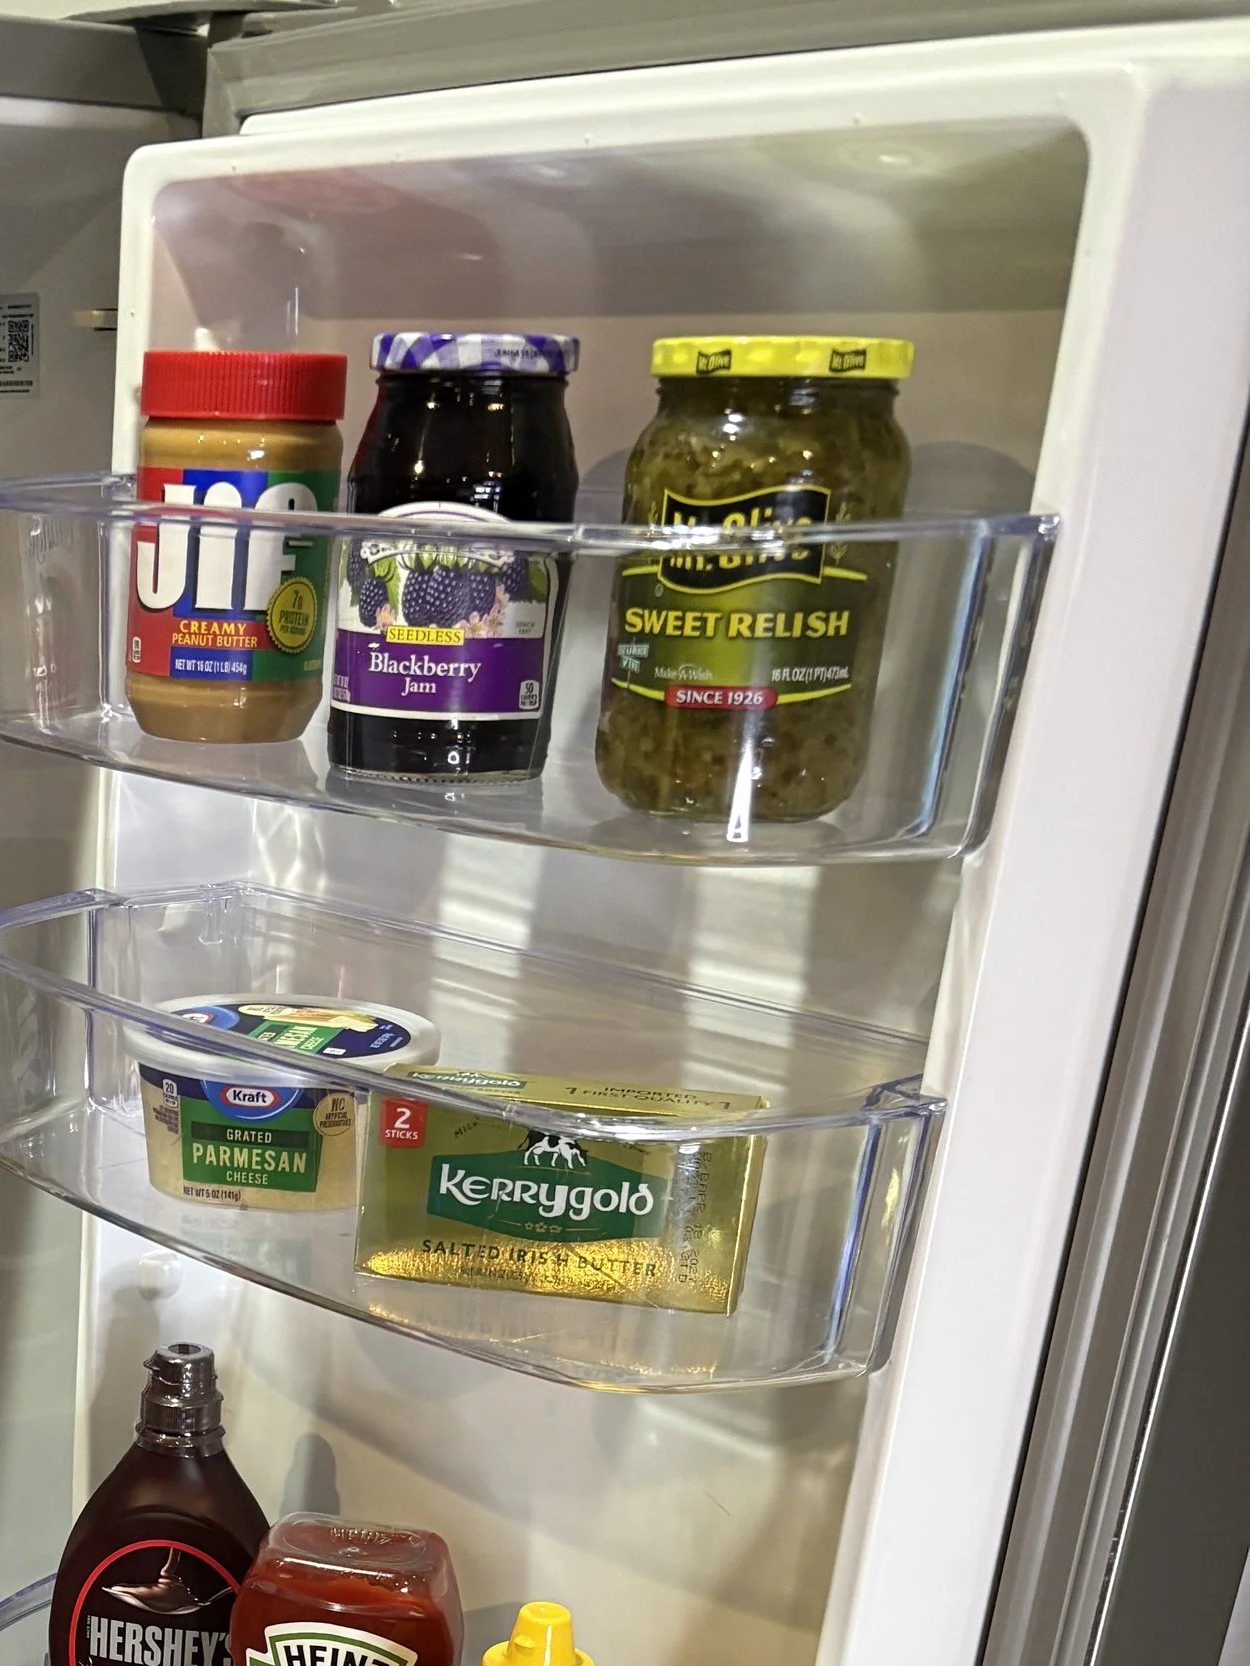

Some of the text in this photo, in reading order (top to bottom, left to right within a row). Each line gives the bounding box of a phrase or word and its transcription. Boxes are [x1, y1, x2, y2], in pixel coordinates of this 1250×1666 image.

[278, 609, 309, 624] PROTEIN
[624, 607, 850, 639] SWEET RELISH
[179, 620, 247, 635] CREAMY
[172, 633, 258, 648] PEANUT BUTTER
[389, 628, 461, 644] SEEDLESS
[175, 658, 247, 675] NET OZ 454g
[368, 651, 482, 683] Blackberry
[401, 677, 437, 696] Jam
[676, 690, 764, 705] SINCE 1926
[164, 1081, 175, 1095] 20
[604, 1087, 697, 1100] IMPORTED
[232, 1089, 267, 1104] Kraft
[583, 1090, 713, 1108] FIRST QUALITY
[394, 1107, 410, 1129] 2
[226, 1128, 272, 1144] GRATED
[385, 1128, 419, 1141] STICKS
[454, 1117, 480, 1139] MILK
[192, 1143, 307, 1174] PARMESAN
[226, 1170, 269, 1185] CHEESE
[183, 1186, 194, 1196] NET
[421, 1238, 500, 1260] SALTED
[509, 1247, 569, 1268] IRISH
[577, 1256, 656, 1278] BUTTER
